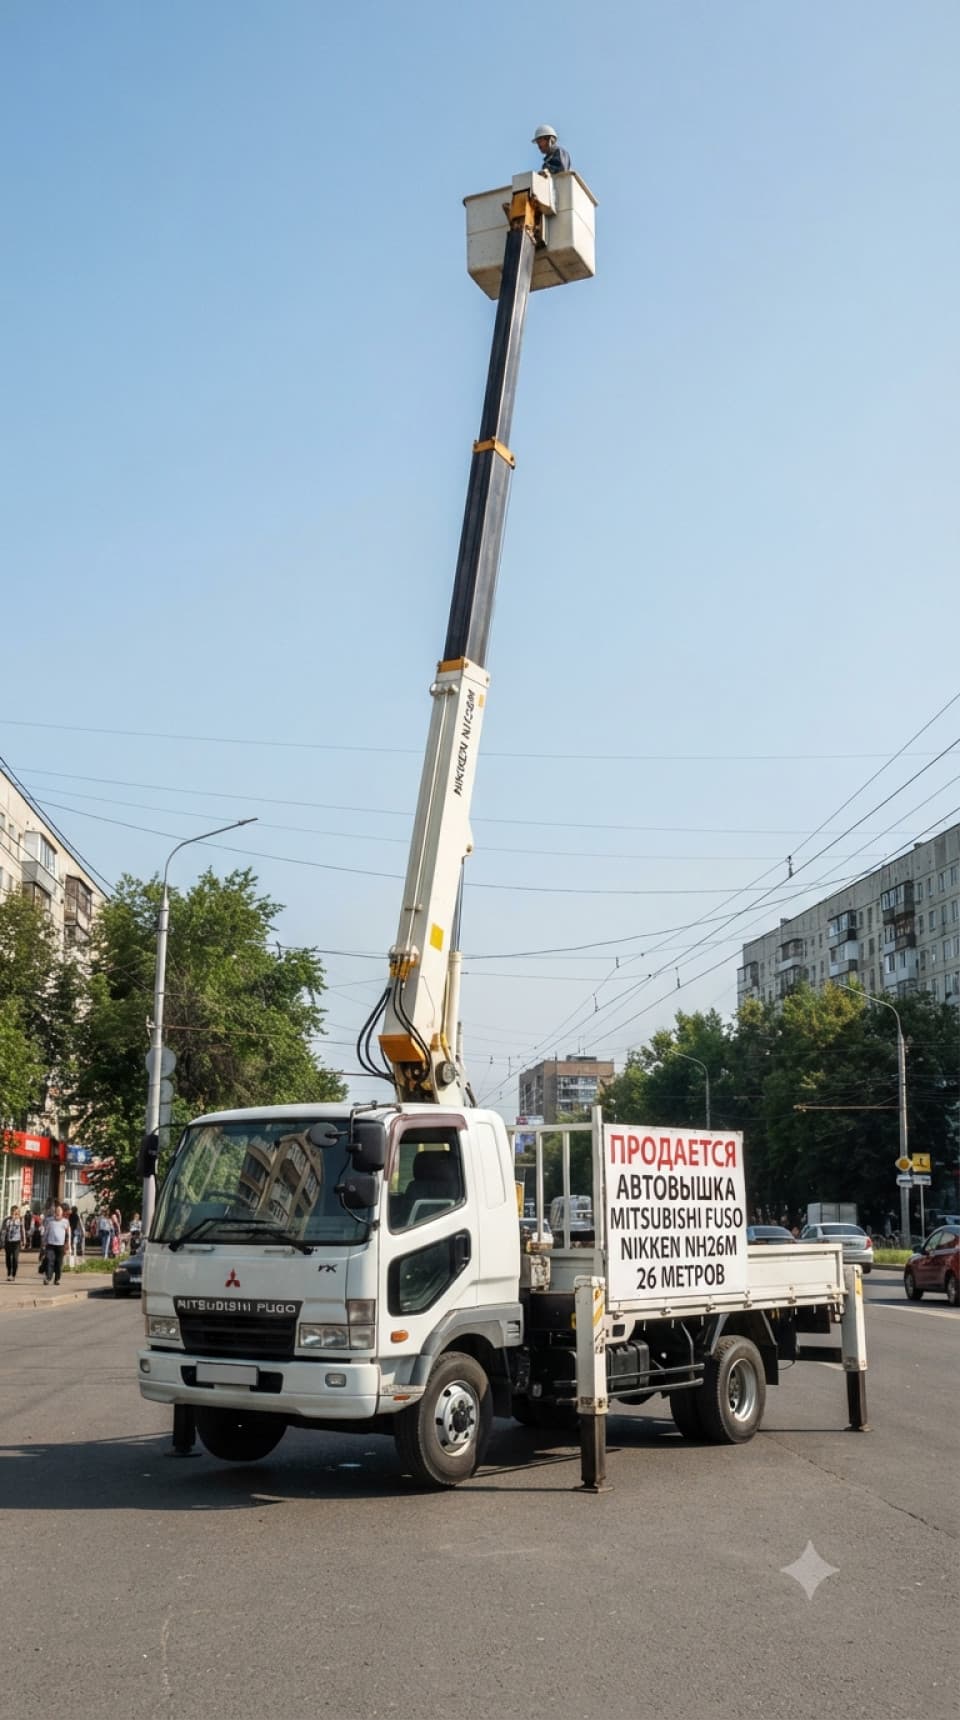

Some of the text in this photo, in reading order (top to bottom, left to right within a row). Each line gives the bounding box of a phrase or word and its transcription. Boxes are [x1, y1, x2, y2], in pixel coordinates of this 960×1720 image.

[610, 1134, 737, 1171] ПРОДАЕТСЯ
[616, 1174, 736, 1201] АВТОВЫШКА
[610, 1207, 743, 1230] MITSUBISHI FUSO
[621, 1235, 737, 1260] NIKKEN NH26M
[637, 1264, 726, 1290] 26 МЕТРОВ
